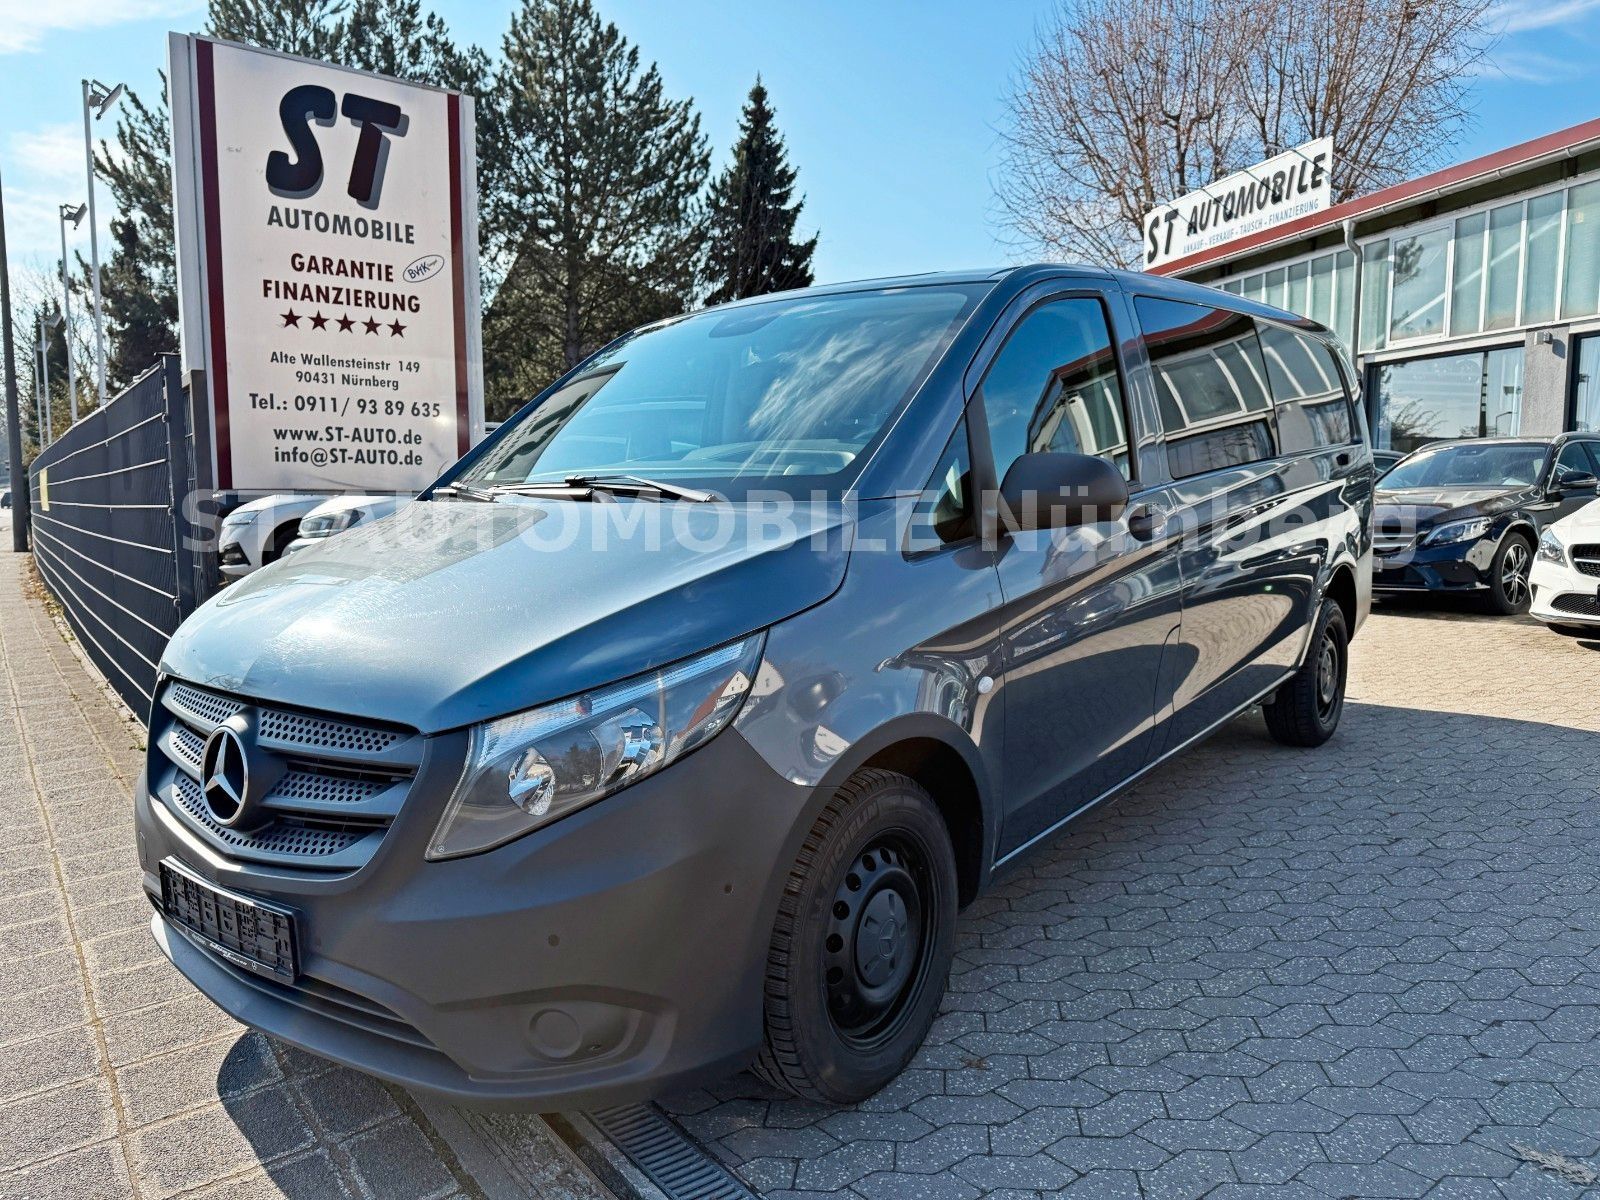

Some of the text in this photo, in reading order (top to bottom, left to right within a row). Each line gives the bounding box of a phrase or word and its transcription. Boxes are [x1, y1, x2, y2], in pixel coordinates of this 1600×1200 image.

[266, 84, 408, 209] ST
[1147, 152, 1326, 264] ST AUTOMOBILE
[1240, 218, 1263, 236] TAUSCH
[1268, 199, 1319, 225] FINANZIERUNG
[267, 205, 415, 244] AUTOMOBILE
[291, 253, 394, 282] GARANTIE
[263, 279, 421, 313] FINANZIERUNG
[270, 351, 420, 373] Alte Wallensteinstr 149
[295, 371, 399, 391] 90431 Nürnberg
[249, 393, 288, 411] Tel.:
[357, 399, 378, 415] 93
[384, 400, 404, 416] 89
[411, 402, 440, 417] 635
[273, 426, 422, 445] www.ST-AUTO.de
[274, 446, 423, 467] info@ST-AUTO.de
